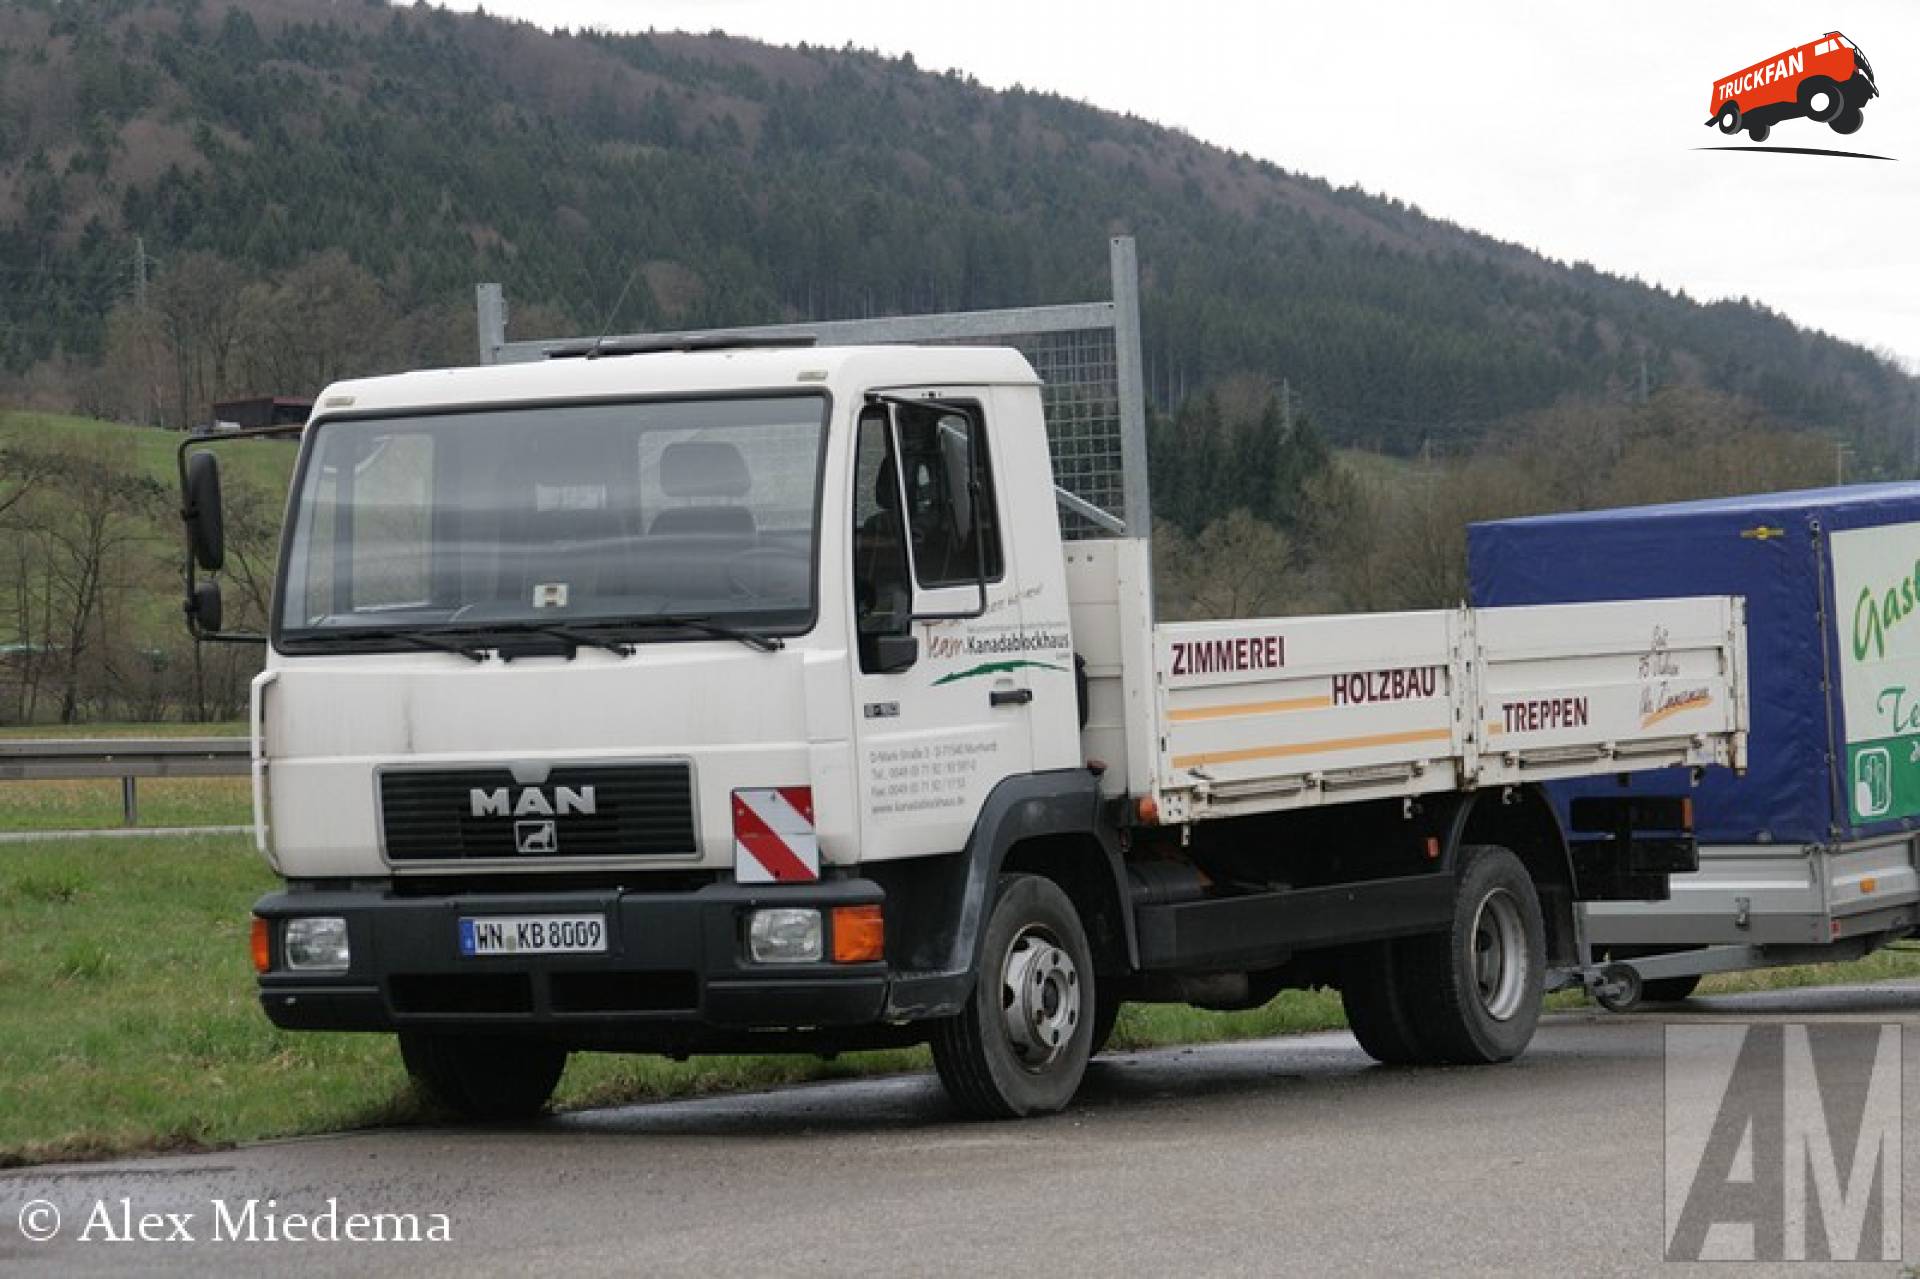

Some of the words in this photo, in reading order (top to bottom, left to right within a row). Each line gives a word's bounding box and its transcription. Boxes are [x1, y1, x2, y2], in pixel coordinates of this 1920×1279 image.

[1171, 635, 1285, 676] ZIMMEREI
[1331, 666, 1436, 706] HOLZBAU
[1502, 696, 1588, 733] TREPPEN
[470, 786, 597, 817] MAN
[475, 922, 503, 949] WN
[517, 921, 546, 949] KB
[549, 920, 601, 948] 8009
